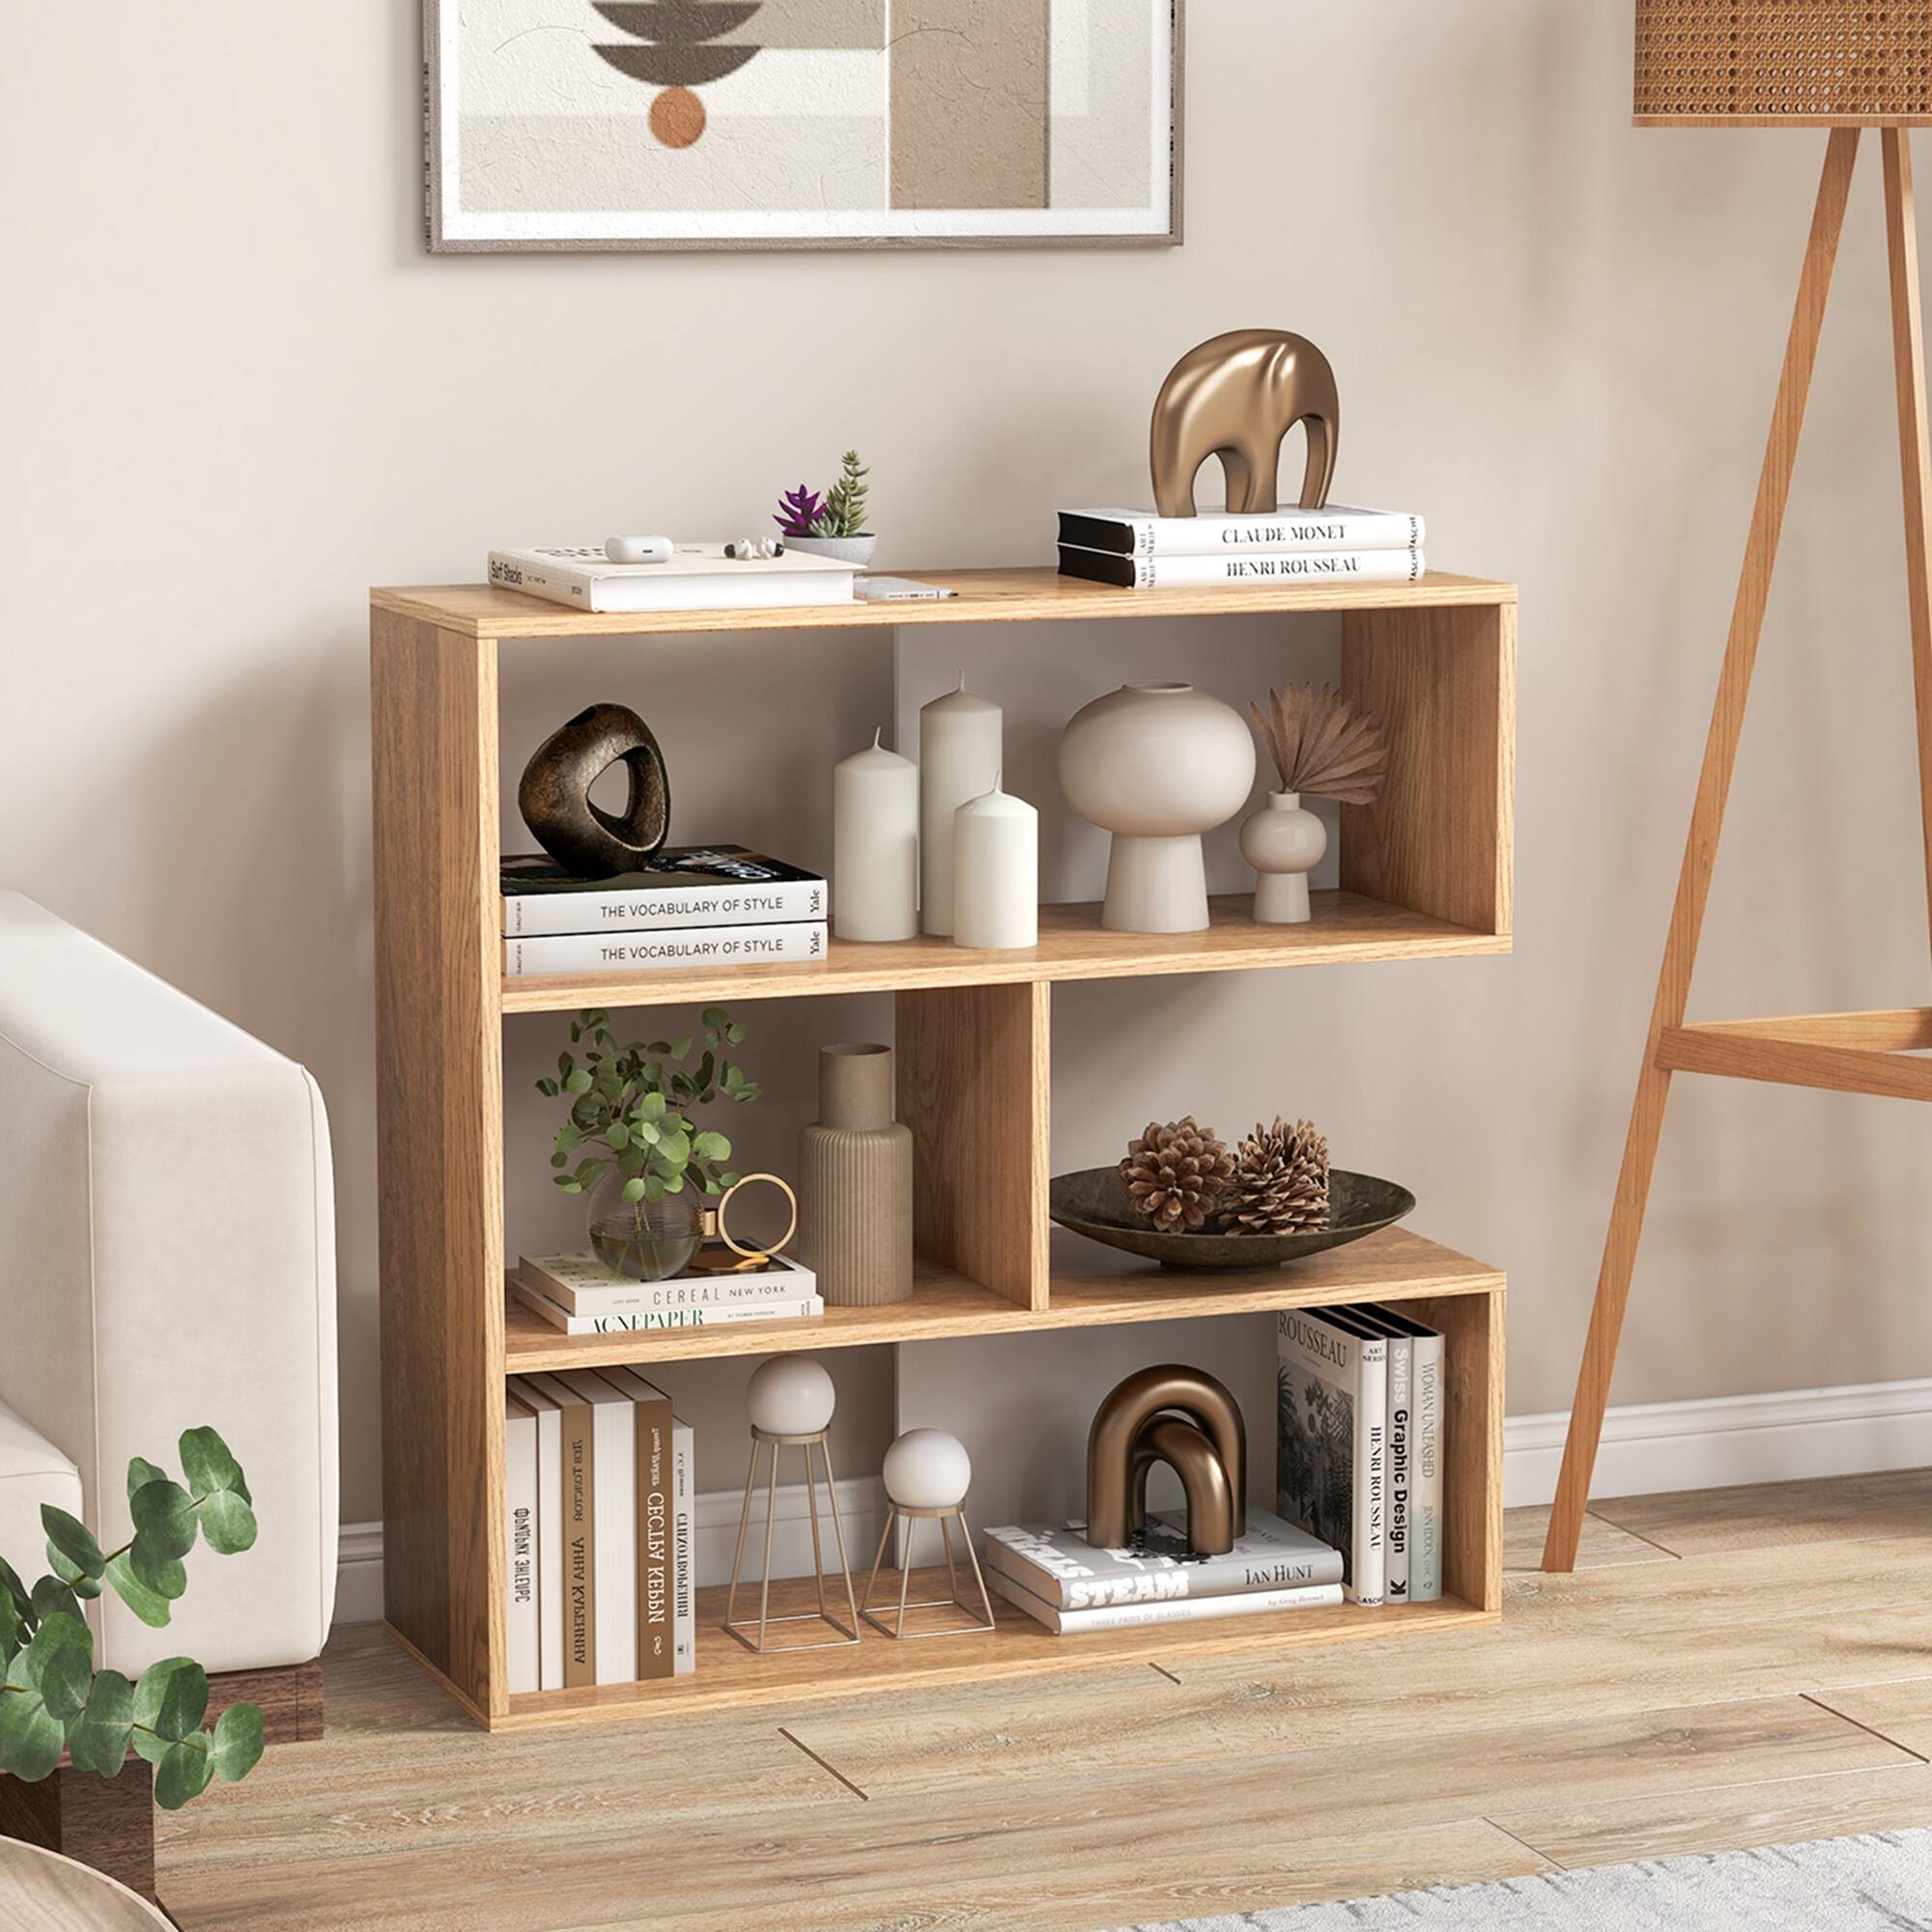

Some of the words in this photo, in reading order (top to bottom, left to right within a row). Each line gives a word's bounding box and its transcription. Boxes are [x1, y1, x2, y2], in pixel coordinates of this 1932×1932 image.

[1222, 527, 1286, 544] CLAUDE
[1291, 525, 1347, 541] MONET
[1227, 560, 1275, 577] HENRI
[1280, 556, 1361, 575] ROUSSEAU
[601, 905, 625, 919] THE
[629, 900, 719, 917] VOCABULARY
[723, 898, 740, 912] OF
[744, 896, 783, 911] STYLE
[810, 889, 820, 913] Yale
[601, 948, 626, 961] THE
[630, 943, 719, 959] VOCABULARY
[723, 941, 740, 954] OF
[744, 939, 783, 952] STYLE
[810, 930, 820, 955] Yale
[653, 1288, 720, 1305] CEREAL
[729, 1288, 753, 1296] NEW
[758, 1285, 786, 1294] YORK
[1279, 1311, 1348, 1368] ROUSSEAU
[1394, 1348, 1408, 1404] Swiss
[1422, 1363, 1435, 1410] WOMAN
[1371, 1427, 1381, 1471] HENRI
[1390, 1409, 1408, 1484] Graphic
[1422, 1413, 1435, 1478] UNLEASHED
[1371, 1476, 1381, 1551] ROUSSEAU
[1390, 1490, 1407, 1553] Design
[1069, 1571, 1190, 1608] STEAM
[1245, 1569, 1270, 1585] IAN
[1274, 1564, 1314, 1582] HUNT
